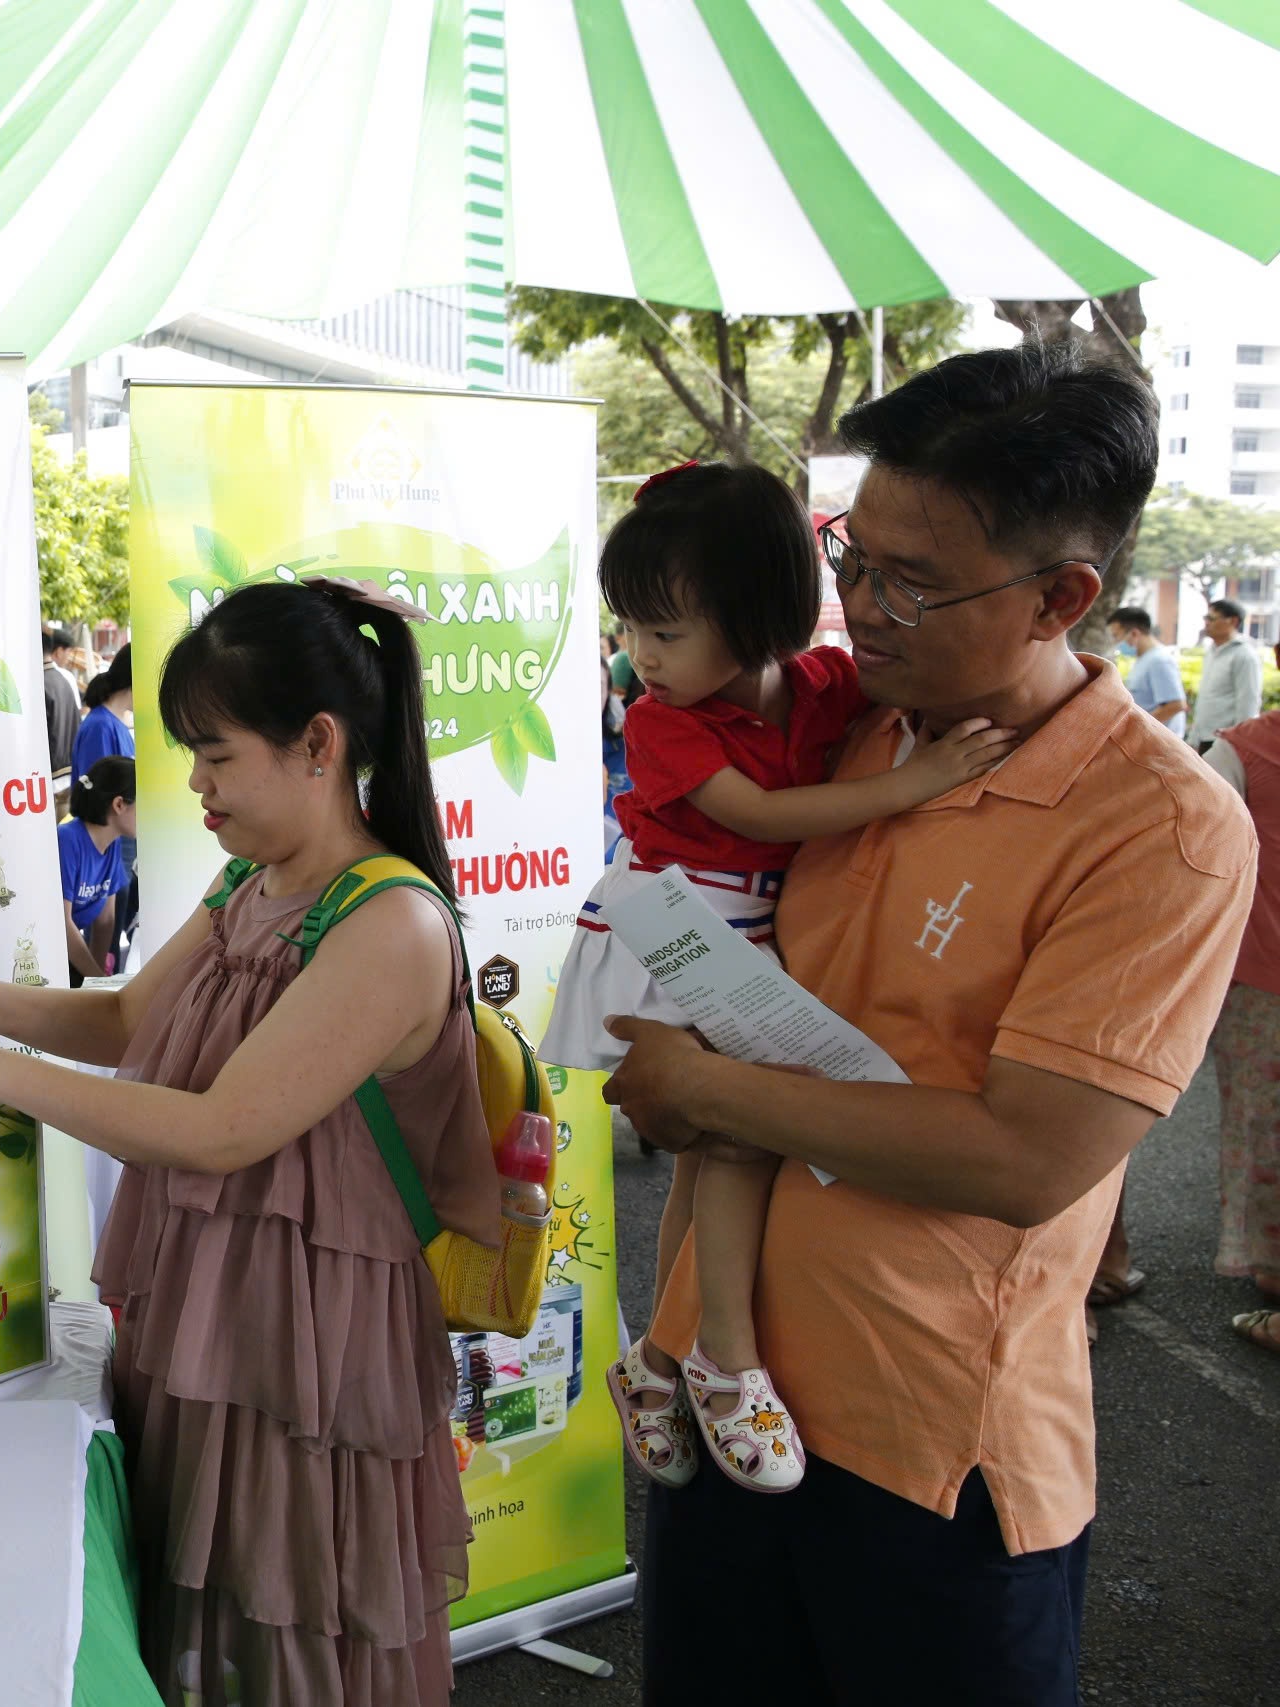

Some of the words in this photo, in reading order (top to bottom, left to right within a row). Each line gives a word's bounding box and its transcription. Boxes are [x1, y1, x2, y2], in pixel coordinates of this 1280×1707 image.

[438, 580, 561, 625] XANH
[423, 642, 545, 696] HƯNG
[2, 771, 48, 817] CŨ
[504, 918, 523, 933] Tài
[526, 916, 544, 932] trợ
[639, 929, 702, 968] LANDSCAPE
[649, 942, 711, 980] IRRIGATION
[484, 972, 512, 986] HONEY
[486, 982, 511, 994] LAND
[498, 1500, 525, 1518] họa
